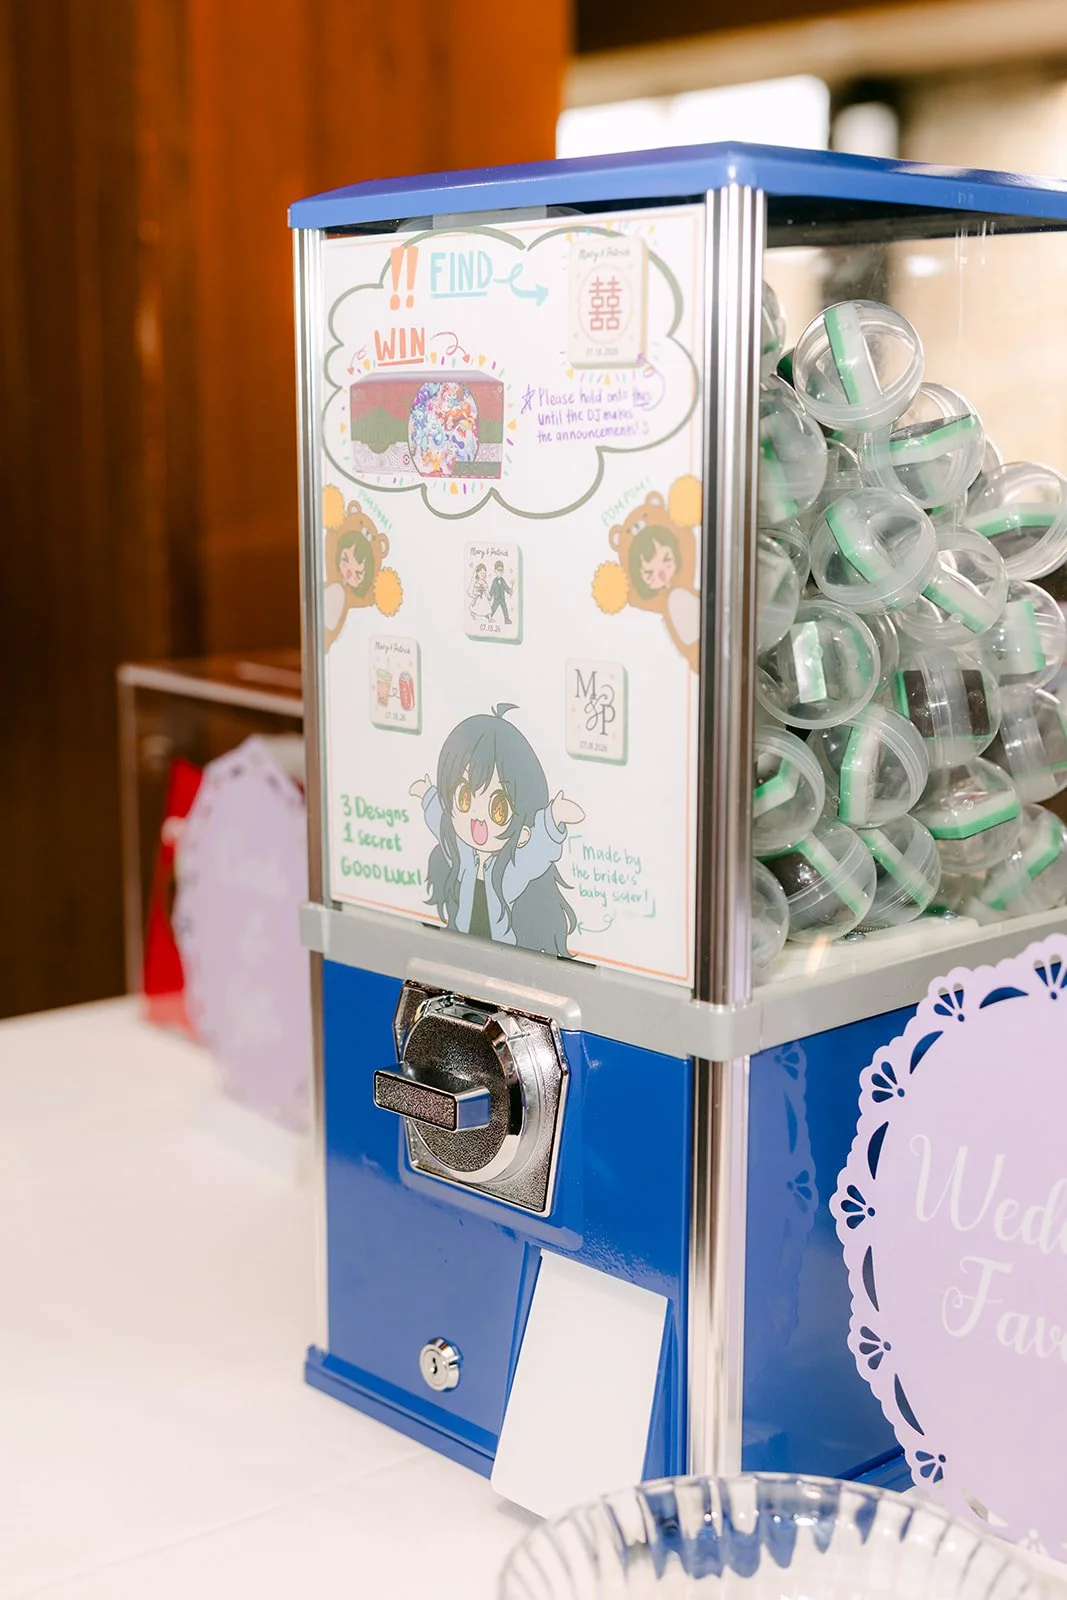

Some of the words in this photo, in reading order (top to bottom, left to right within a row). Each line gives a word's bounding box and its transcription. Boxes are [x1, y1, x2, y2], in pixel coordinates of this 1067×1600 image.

[430, 250, 493, 292] FIND
[374, 327, 425, 361] WIN
[538, 386, 575, 407] Please
[579, 386, 603, 404] hold
[607, 388, 628, 403] onto
[537, 409, 562, 426] until
[567, 408, 583, 424] the
[587, 409, 601, 422] DJ
[603, 408, 634, 421] makes
[537, 430, 552, 443] the
[574, 668, 598, 698] M
[600, 704, 616, 736] P
[340, 794, 352, 817] 3
[355, 796, 410, 827] Designs
[343, 822, 354, 843] 1
[358, 829, 402, 852] secret
[569, 863, 590, 880] the
[593, 866, 638, 886] bride's
[625, 848, 641, 875] by
[579, 884, 608, 907] baby
[909, 1134, 1067, 1256] Wed
[942, 1256, 1067, 1364] Fav
